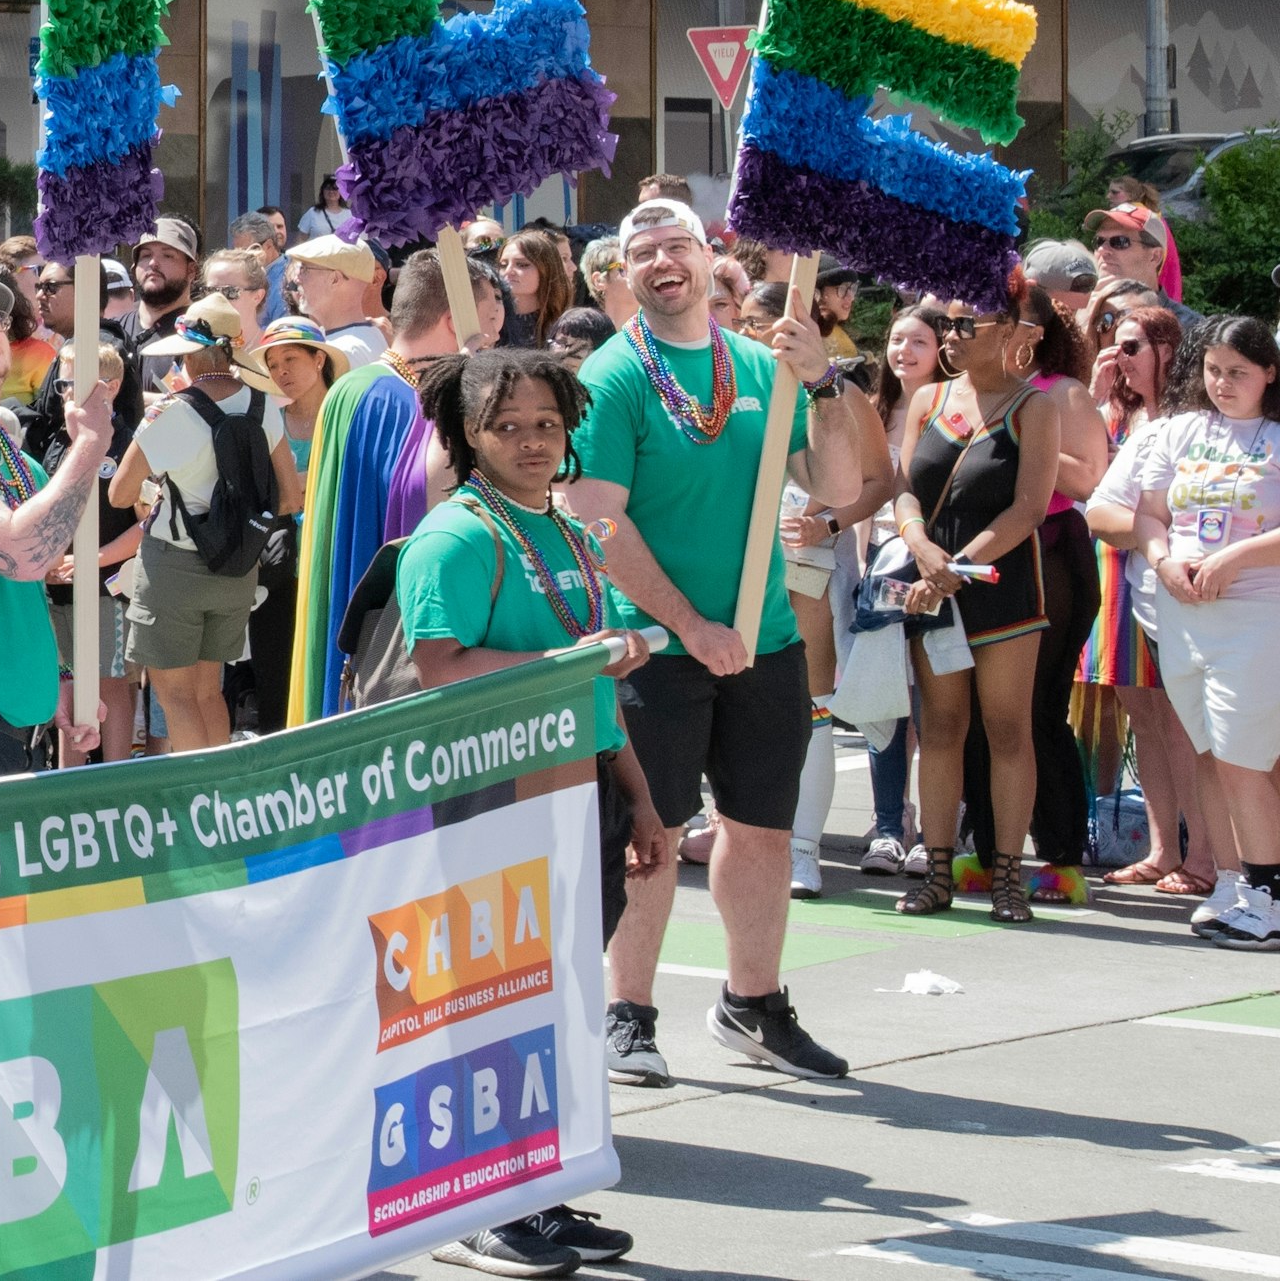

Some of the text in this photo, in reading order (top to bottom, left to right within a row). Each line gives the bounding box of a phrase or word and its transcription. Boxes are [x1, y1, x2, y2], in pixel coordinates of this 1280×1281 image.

[713, 47, 735, 58] YIELD
[14, 804, 178, 877] LGBTQ+
[190, 772, 348, 848] Chamber
[361, 746, 395, 805] of
[405, 708, 576, 792] Commerce
[383, 885, 541, 992] CHBA
[381, 970, 549, 1044] CAPITOL HILL BUSINESS ALLIANCE
[379, 1052, 550, 1167] GSBA
[373, 1144, 556, 1223] SCHOLARSHIP & EDUCATION FUND
